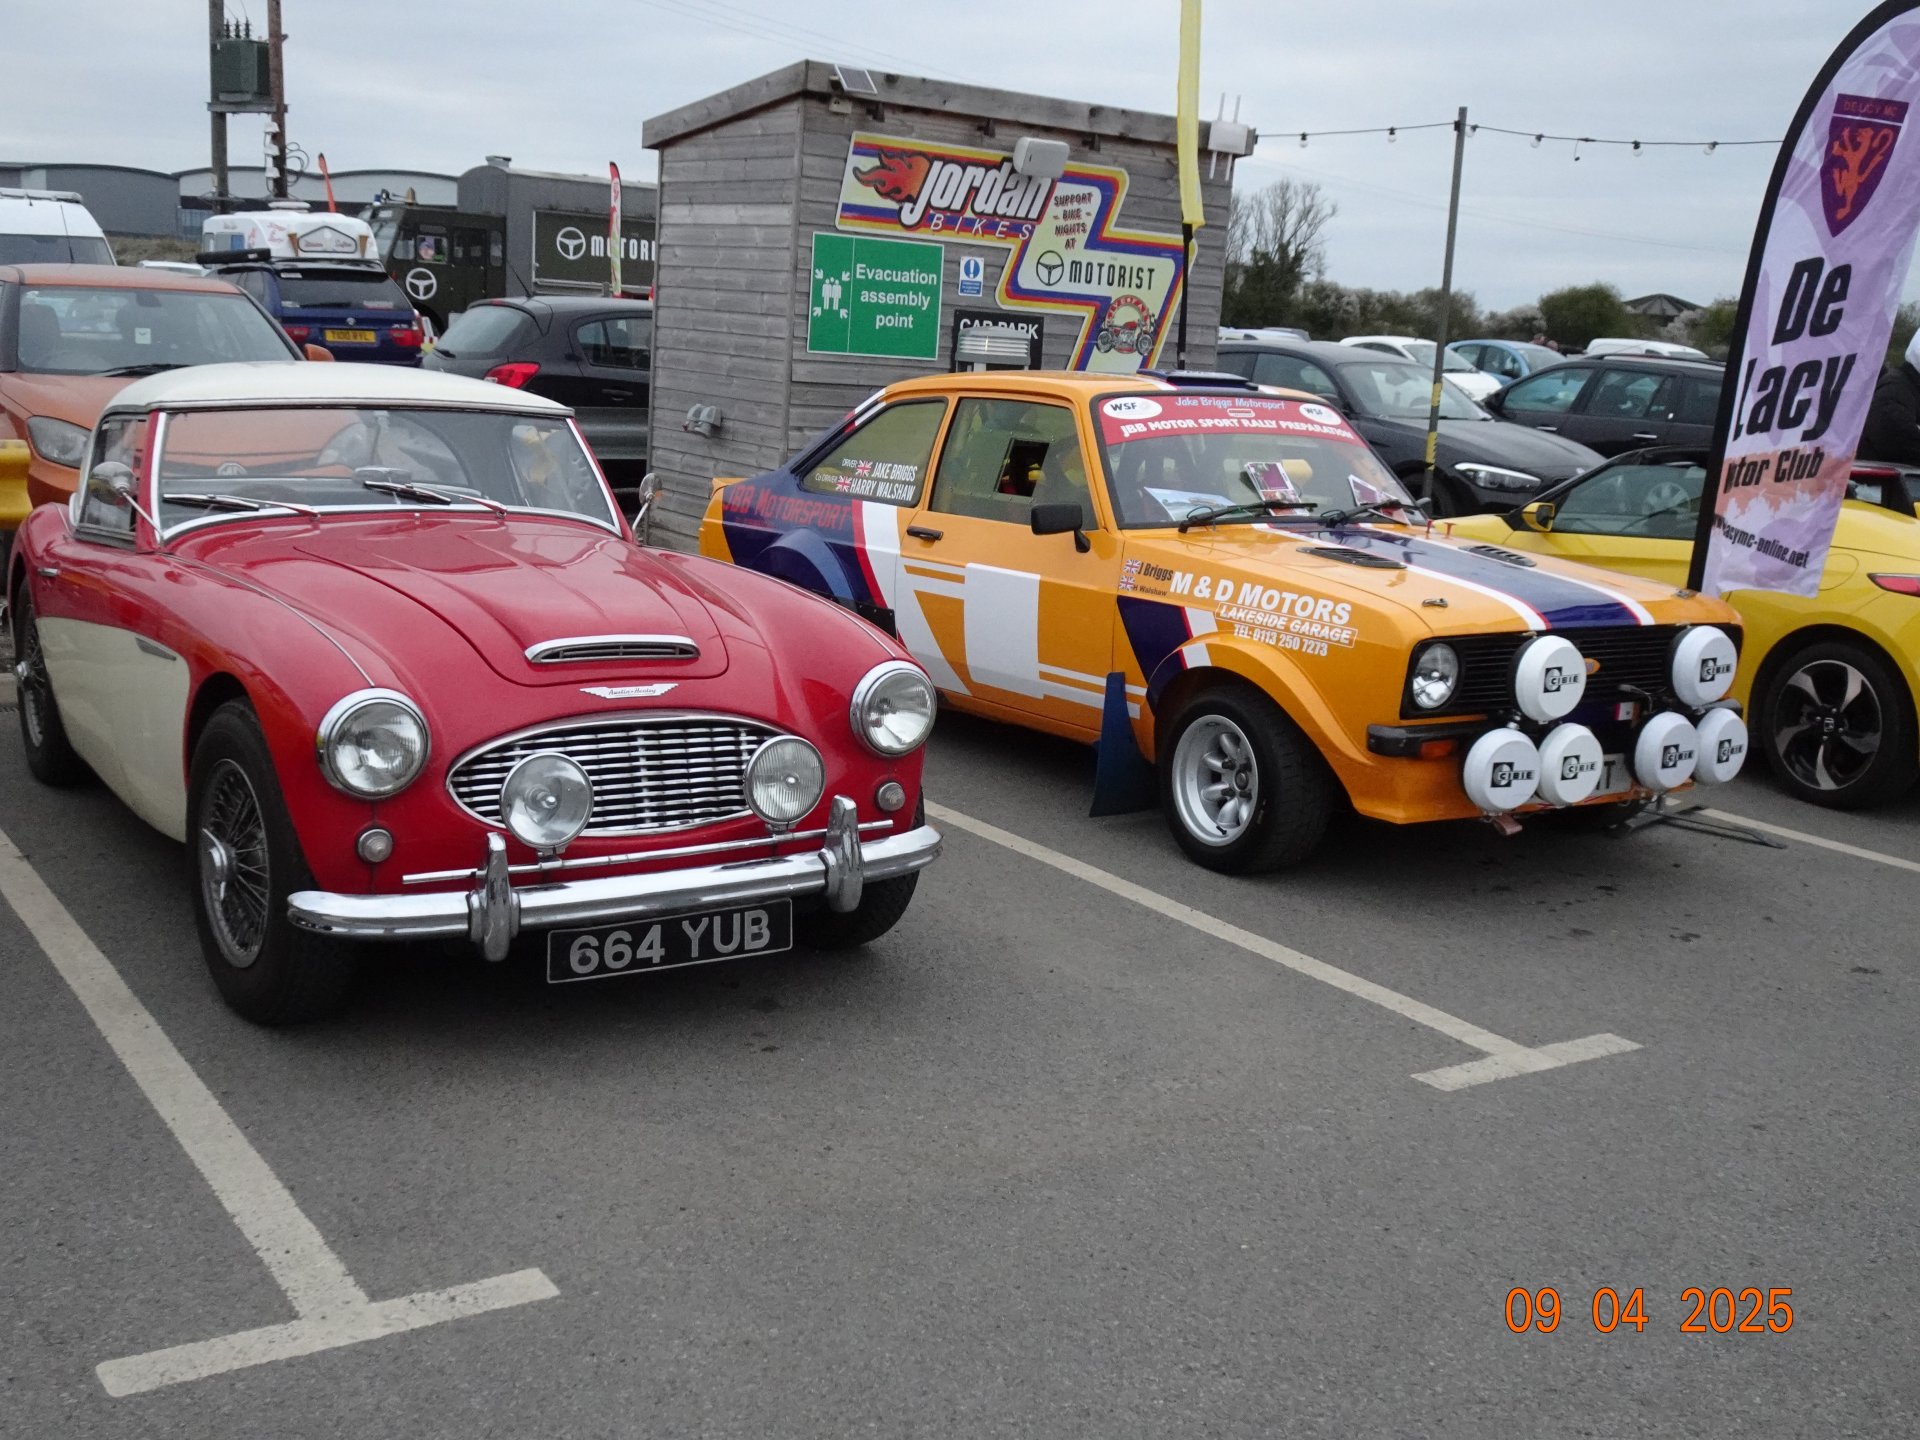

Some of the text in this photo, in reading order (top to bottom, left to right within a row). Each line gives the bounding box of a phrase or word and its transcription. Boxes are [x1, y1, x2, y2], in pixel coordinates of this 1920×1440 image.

[1054, 192, 1093, 206] SUPPORT
[1062, 208, 1081, 221] BIKE
[930, 213, 1033, 240] BIKES
[1055, 223, 1087, 237] NIGHTS
[1064, 238, 1076, 250] AT
[855, 263, 938, 285] Evacuation
[1069, 260, 1155, 290] MOTORIST
[860, 290, 931, 311] assembly
[1771, 256, 1852, 346] De
[875, 312, 914, 330] point
[1110, 402, 1137, 412] WSF
[1175, 397, 1285, 410] Jake Briggs Motorsport
[1120, 418, 1355, 440] JBB MOTOR SPORT RALLY PREPARATION
[871, 462, 892, 478] JAKE
[890, 464, 917, 482] BRIGGS
[1774, 446, 1826, 484] Club
[850, 479, 877, 496] HARRY
[876, 481, 916, 502] WALSHAW
[1143, 564, 1174, 582] Briggs
[1139, 586, 1168, 597] Walshaw
[1170, 571, 1353, 626] M & D MOTORS
[1220, 606, 1352, 644] LAKESIDE GARAGE
[1253, 630, 1277, 645] 0113
[1279, 636, 1301, 650] 250
[1550, 674, 1579, 685] CIBIE
[1499, 770, 1533, 780] CIBIE
[1568, 763, 1595, 773] CIBIE
[569, 909, 771, 974] 664 YUB
